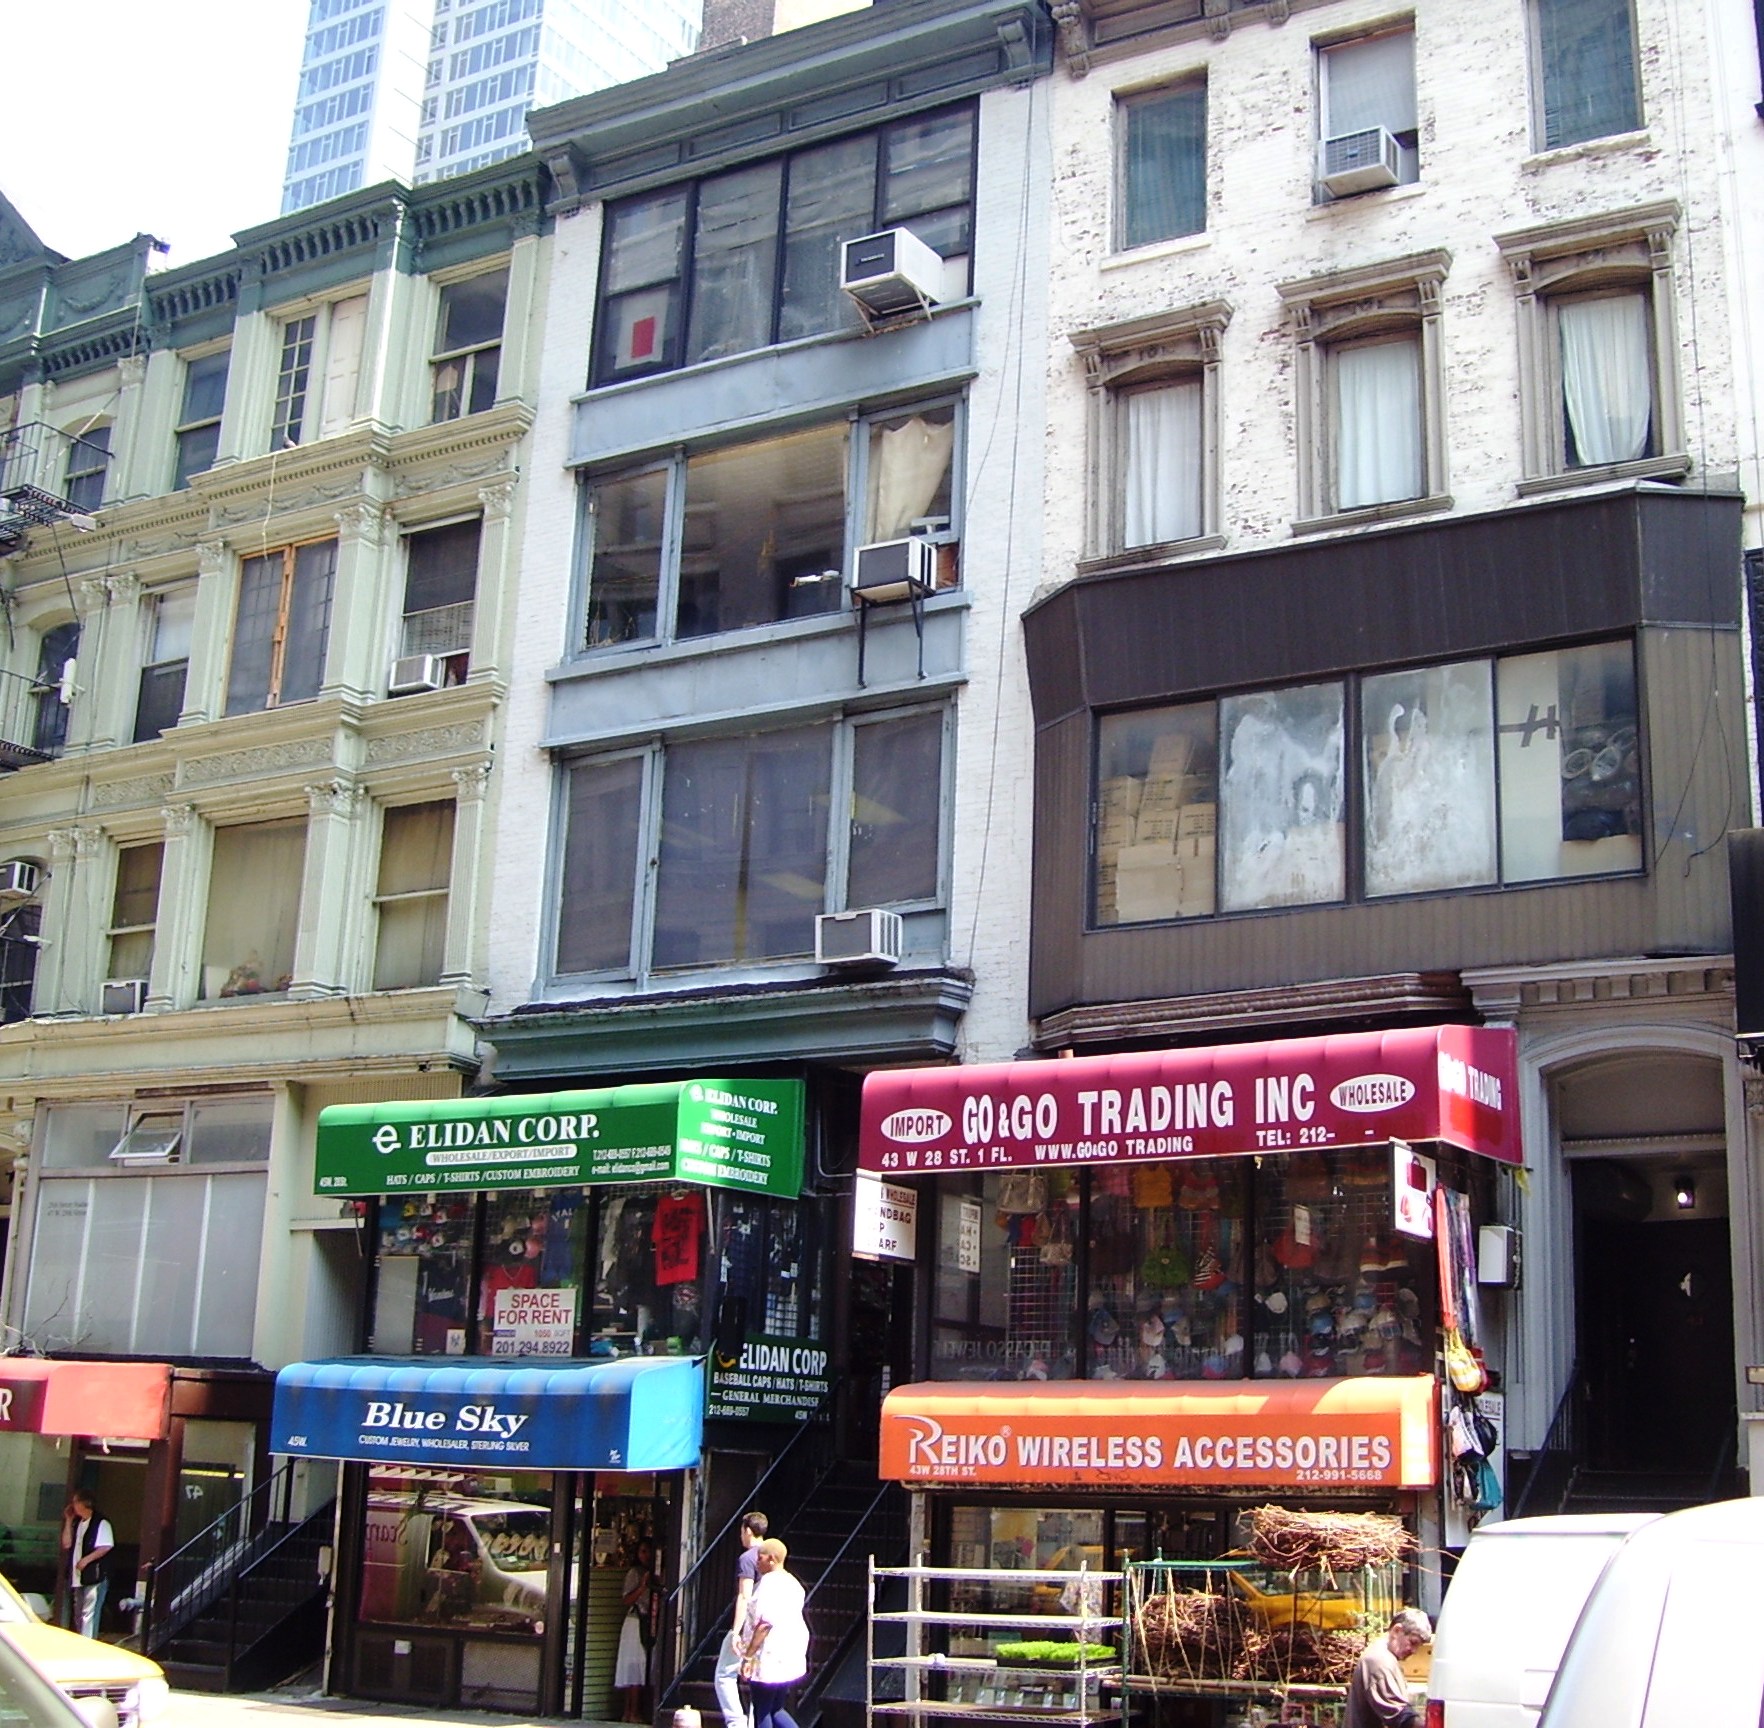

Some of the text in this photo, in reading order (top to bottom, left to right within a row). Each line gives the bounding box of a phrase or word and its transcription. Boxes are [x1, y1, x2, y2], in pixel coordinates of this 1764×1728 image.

[705, 1088, 746, 1109] ELIDAN
[748, 1098, 778, 1115] CORP.
[1339, 1081, 1406, 1106] WHOLESALE
[962, 1073, 1315, 1145] GO&GO TRADING INC
[409, 1119, 512, 1149] ELIDAN
[518, 1114, 601, 1143] CORP.
[890, 1114, 944, 1137] IMPORT
[1125, 1136, 1193, 1156] TRADING
[1256, 1130, 1292, 1148] TEL:
[881, 1147, 1013, 1168] 43 W 28 ST. 1 FL.
[386, 1174, 407, 1186] HATS
[415, 1172, 435, 1185] CAPS
[443, 1170, 480, 1183] T-SHIRTS
[523, 1165, 580, 1179] EMBROIDERY
[511, 1293, 560, 1309] SPACE
[498, 1309, 572, 1325] FOR RENT
[495, 1341, 570, 1354] 201.294.8922
[740, 1343, 828, 1376] ELIDAN CORP
[714, 1372, 751, 1387] BASEBALL
[753, 1375, 772, 1388] CAPS
[776, 1378, 795, 1391] HATS
[799, 1380, 829, 1393] T-SHIRTS
[722, 1390, 760, 1403] GENERAL
[361, 1402, 528, 1438] Blue Sky
[358, 1435, 388, 1446] CUSTOM
[471, 1440, 505, 1451] STERLING
[506, 1441, 530, 1451] SILVER
[892, 1414, 1391, 1469] REIKO WIRELESS ACCESSORIES
[909, 1465, 977, 1477] 43W 28TH ST.
[1296, 1469, 1383, 1482] 212-991-5668
